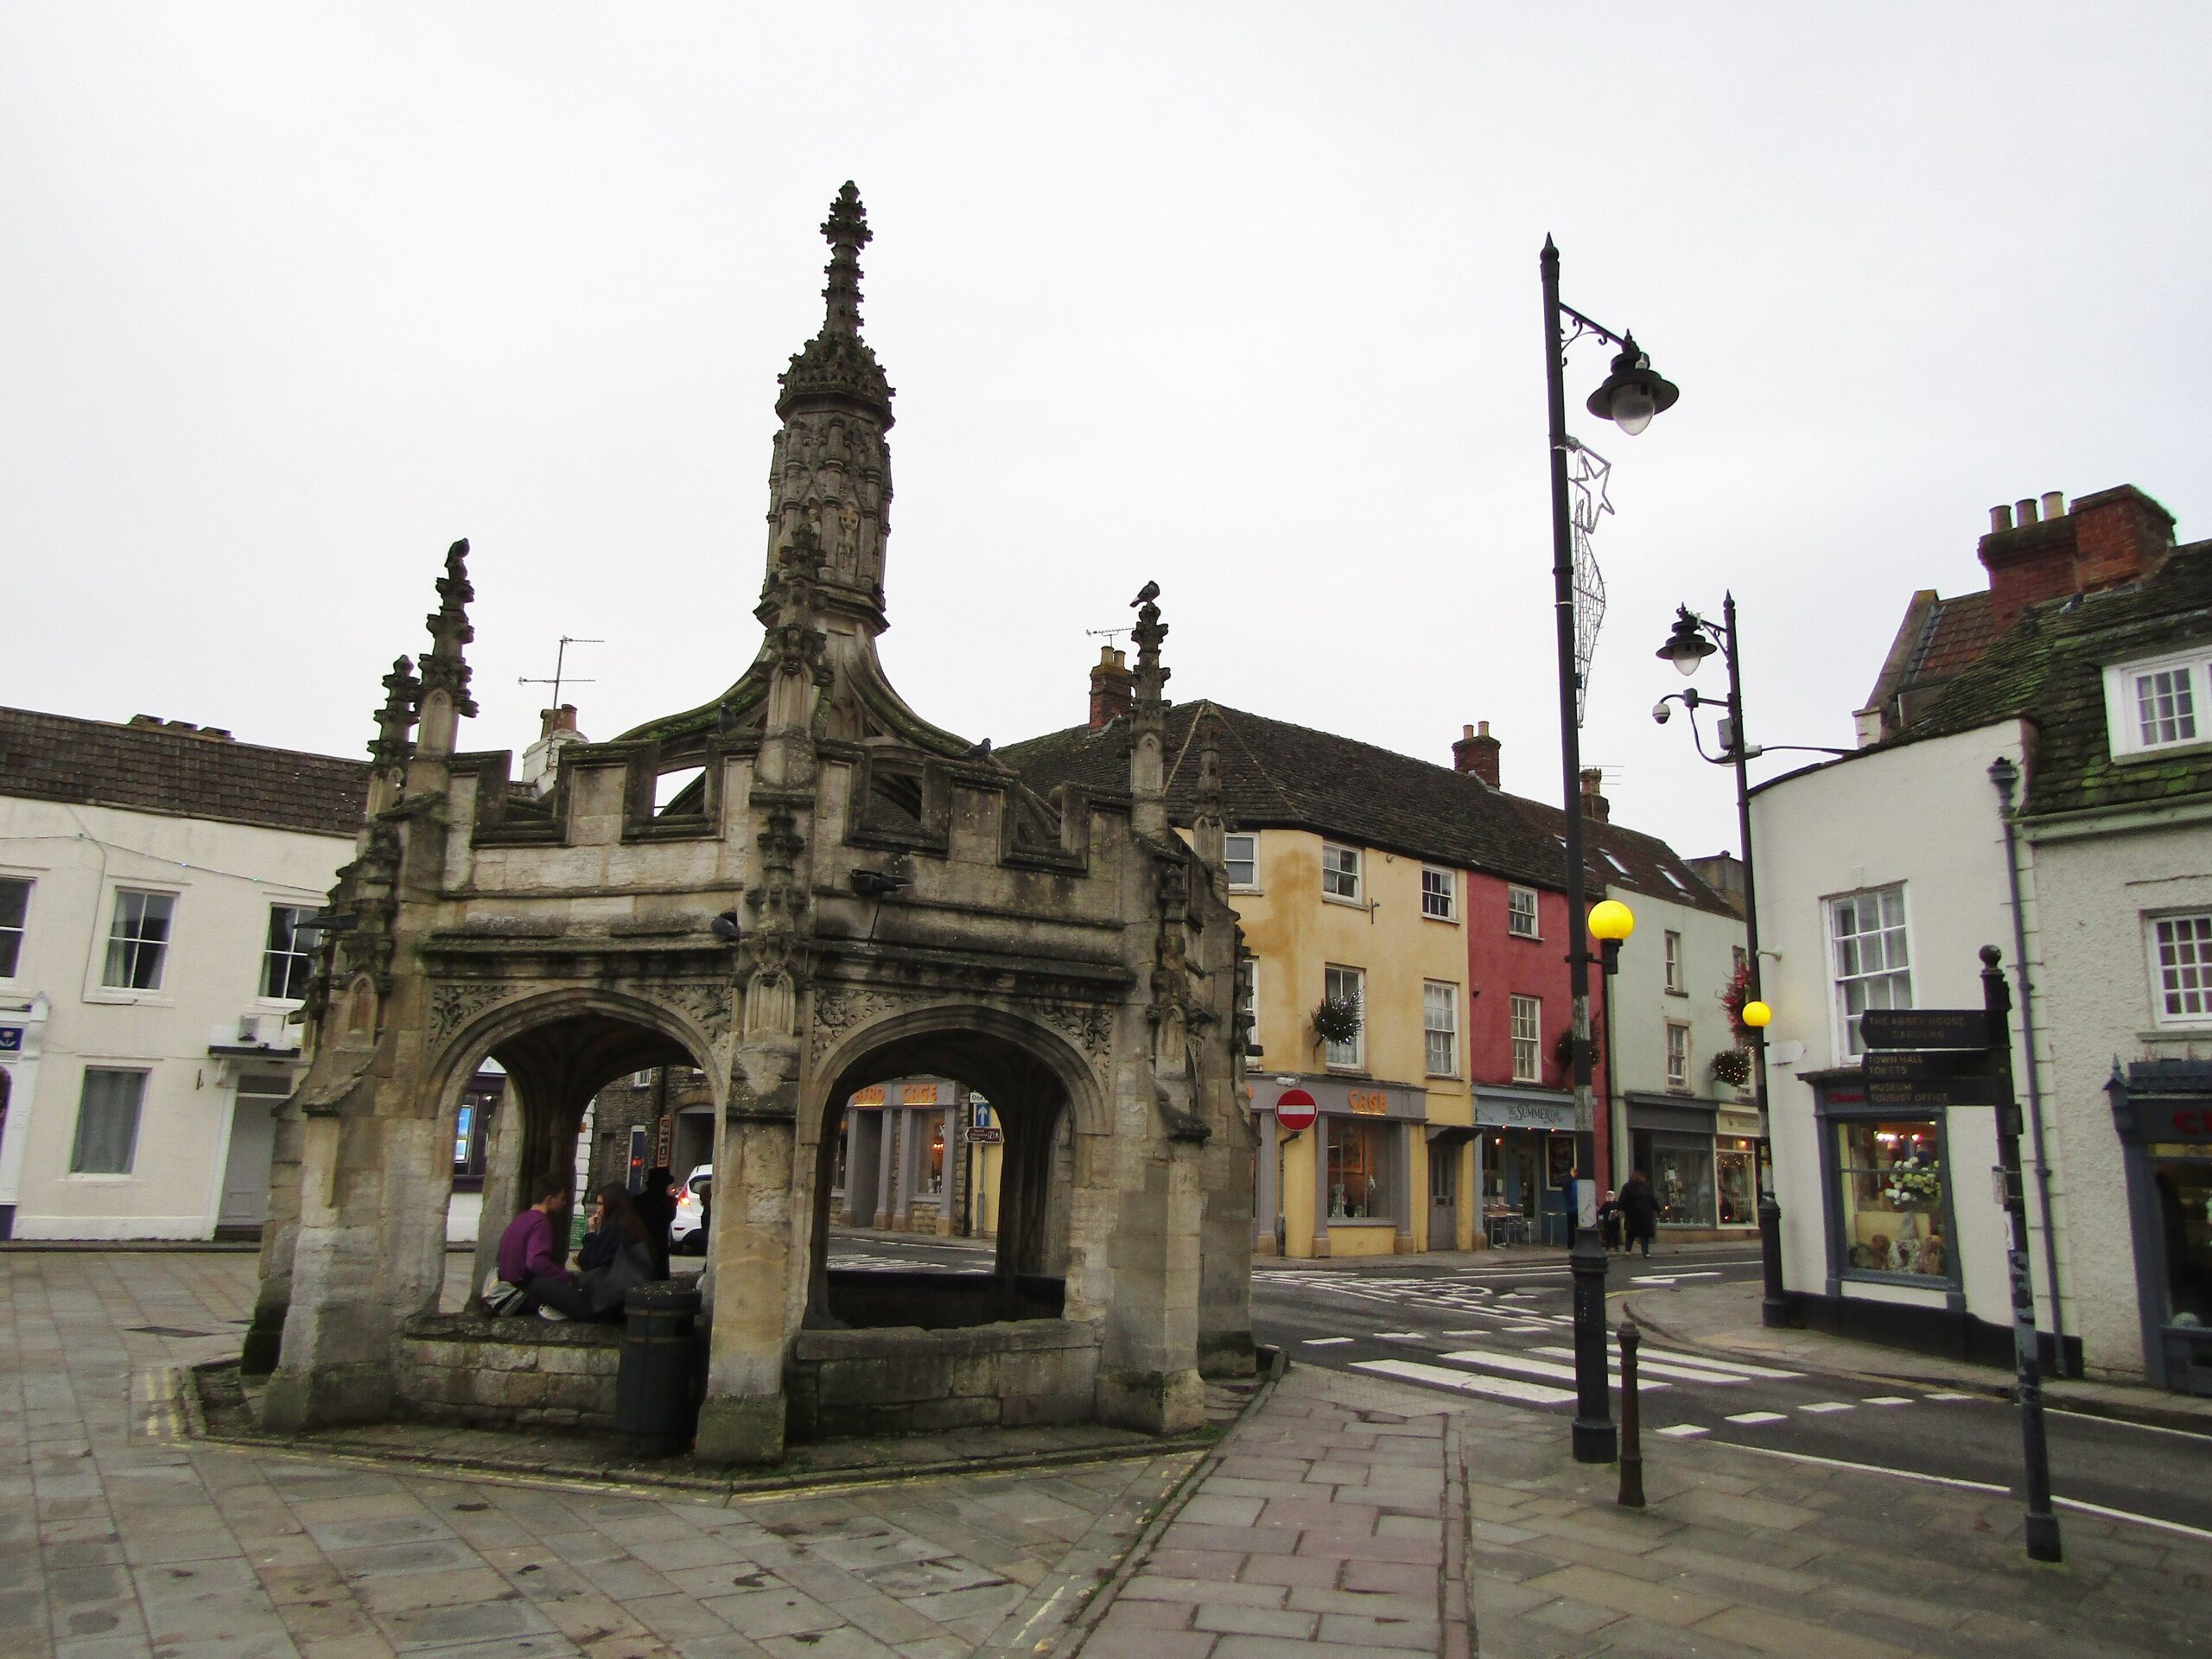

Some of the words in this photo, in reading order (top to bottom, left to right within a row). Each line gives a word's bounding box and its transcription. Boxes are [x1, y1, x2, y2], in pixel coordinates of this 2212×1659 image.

[1868, 1016, 1888, 1026] THE
[1891, 1016, 1923, 1026] ABBEY
[1928, 1016, 1966, 1026] HOUSE
[1868, 1056, 1897, 1065] TOWN
[1899, 1055, 1923, 1064] HALL
[1869, 1065, 1908, 1075] TOILETS
[1869, 1083, 1913, 1091] MUSEUM
[854, 1084, 886, 1103] BIRD
[902, 1083, 938, 1103] CAGE
[1871, 1093, 1910, 1103] TOURIST
[1914, 1092, 1949, 1103] OFFICE
[1348, 1090, 1387, 1111] CAGE
[1517, 1105, 1551, 1122] SUMMER
